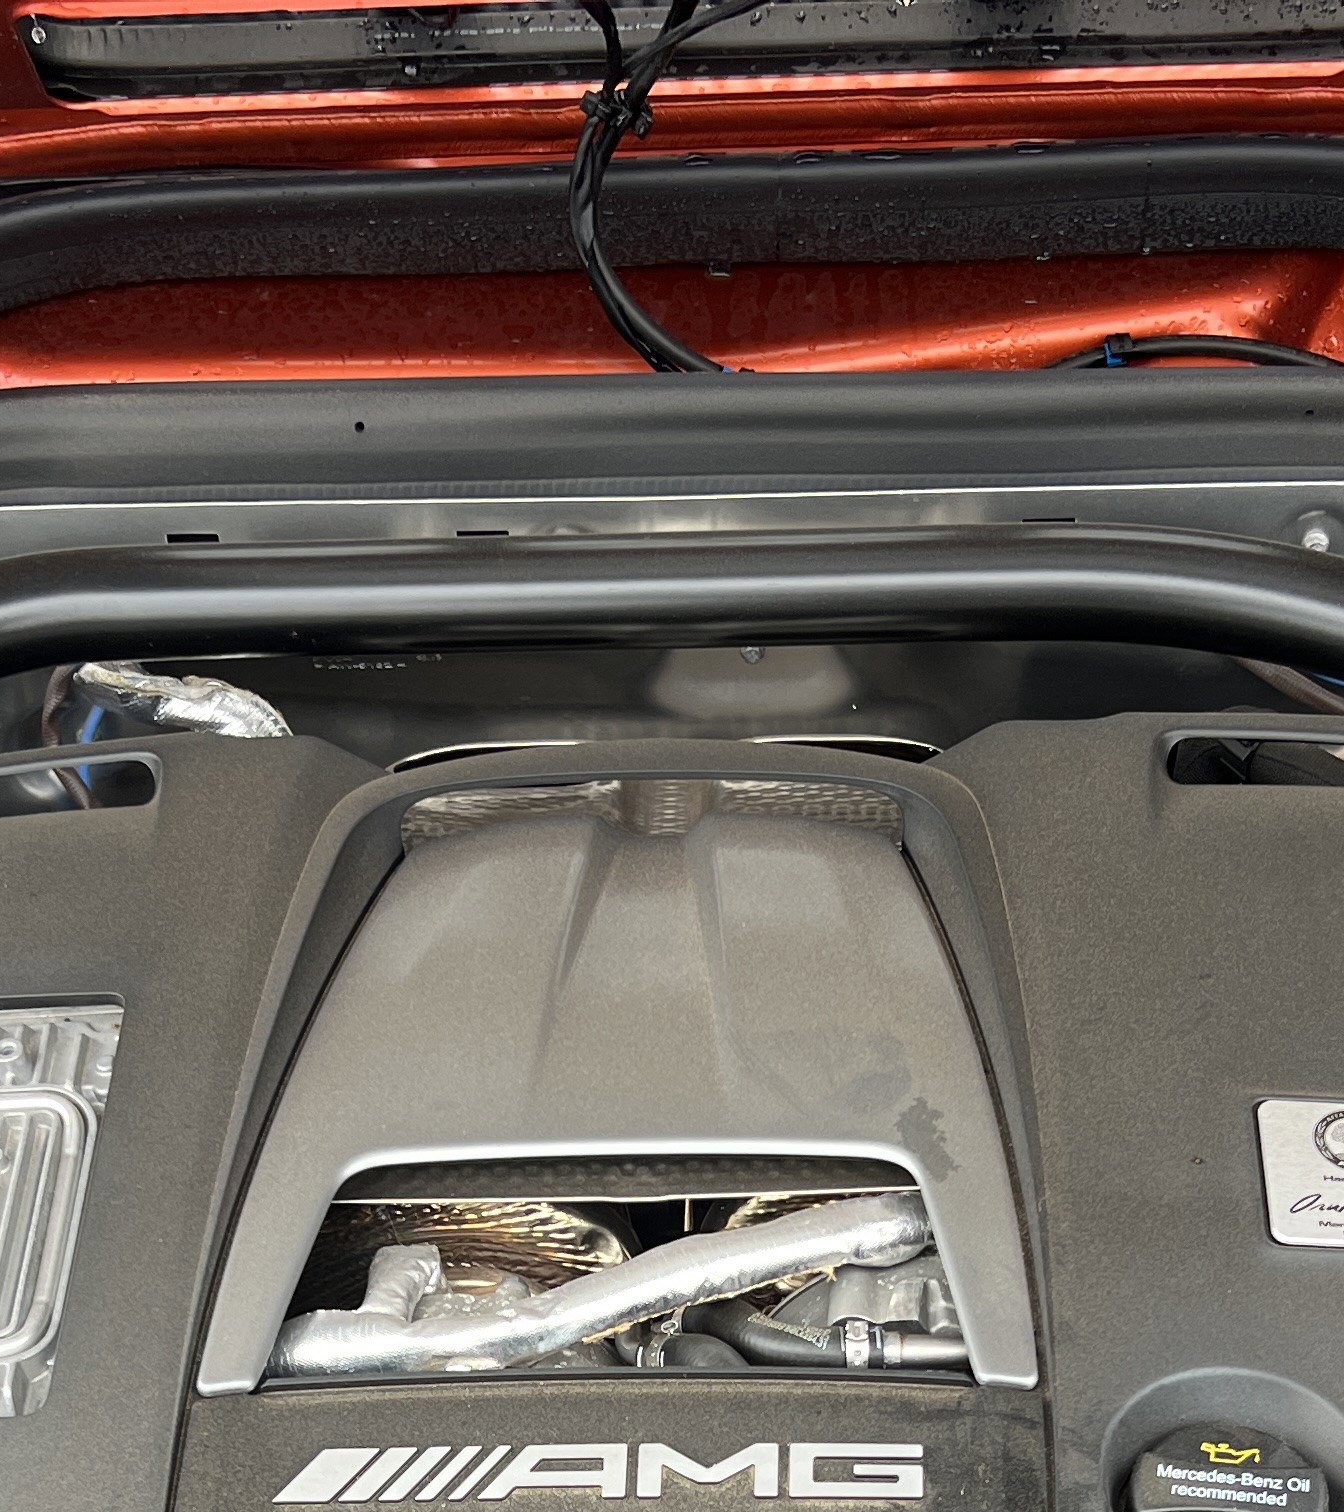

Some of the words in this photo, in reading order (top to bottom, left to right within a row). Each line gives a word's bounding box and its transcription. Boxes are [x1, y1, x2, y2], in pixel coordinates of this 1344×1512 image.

[477, 1442, 924, 1500] AMG
[1156, 1463, 1283, 1490] Mercedes-Benz
[1287, 1477, 1311, 1492] Oil
[1170, 1484, 1288, 1507] recommended
